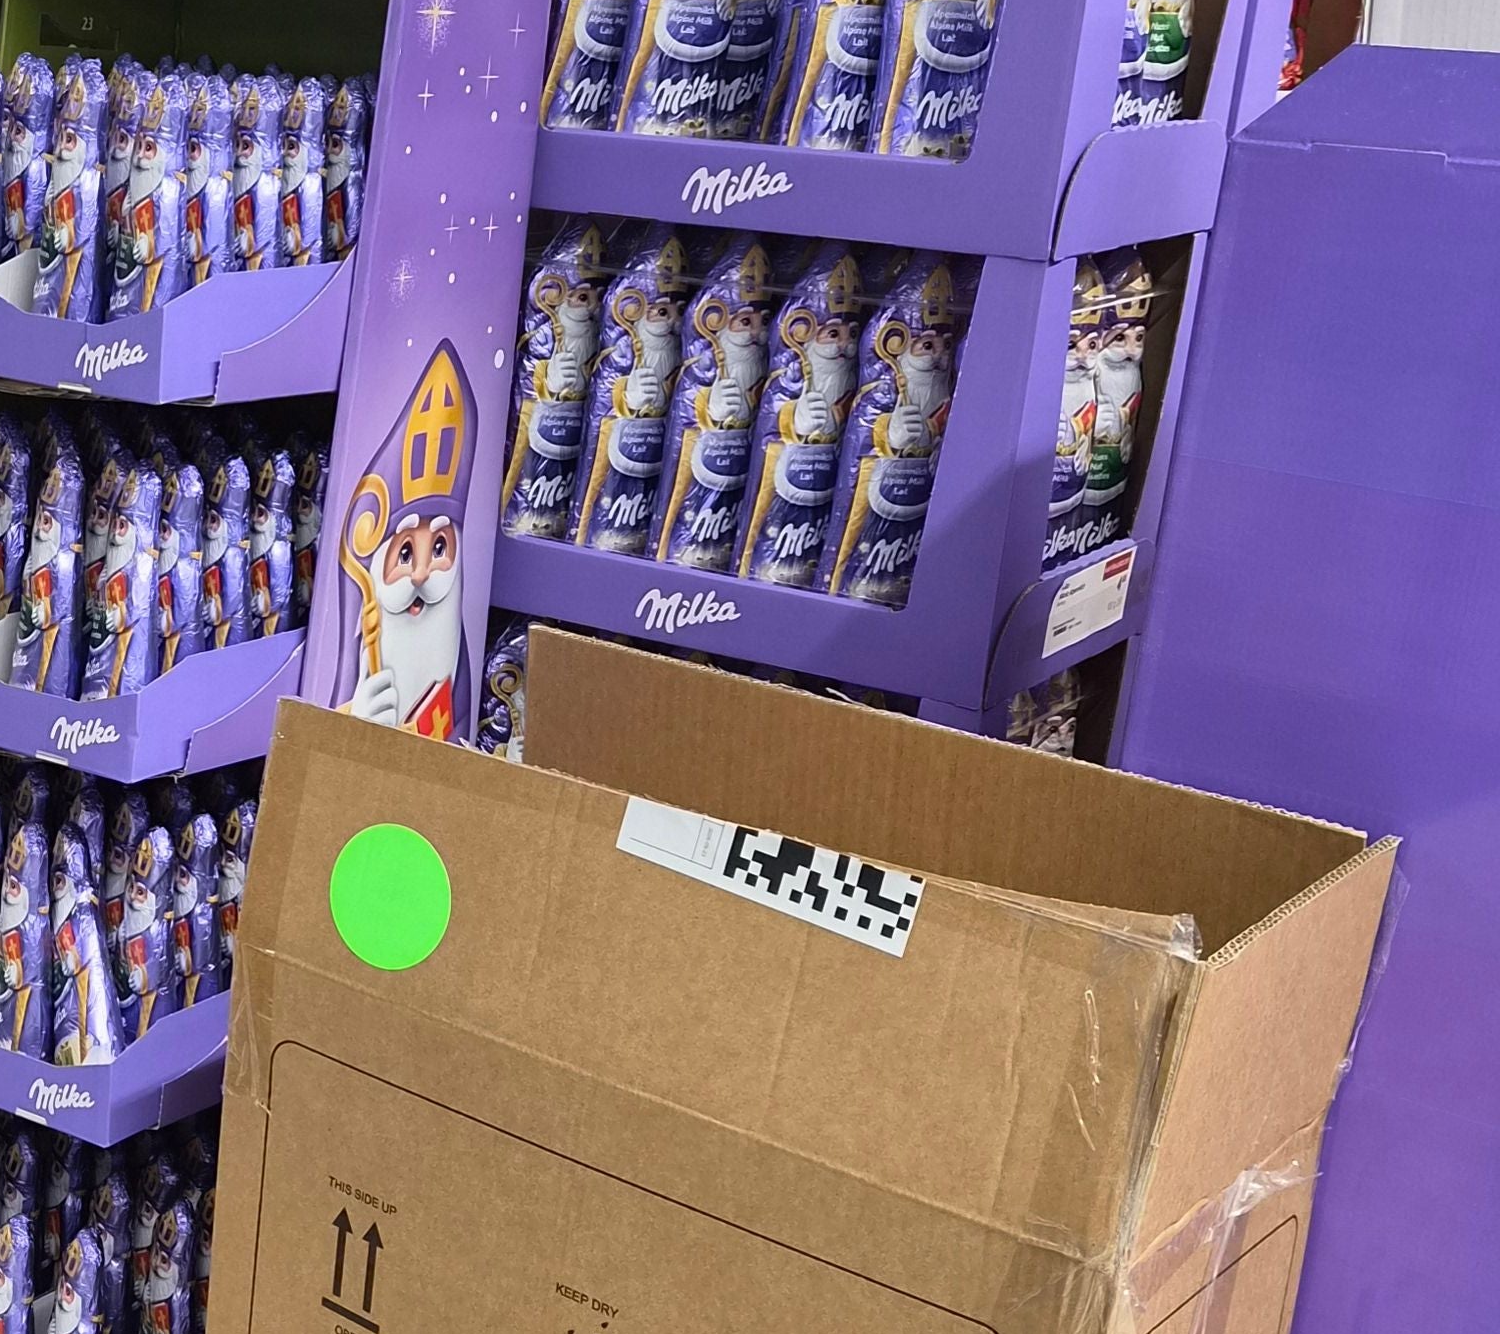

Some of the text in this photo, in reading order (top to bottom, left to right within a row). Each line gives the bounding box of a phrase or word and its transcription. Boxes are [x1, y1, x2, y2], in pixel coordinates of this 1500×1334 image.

[651, 73, 717, 115] Milka
[717, 72, 764, 111] Milk
[681, 161, 793, 215] Milka
[76, 338, 148, 380] Milka
[527, 471, 576, 508] Mil
[866, 529, 922, 574] Milk
[635, 589, 741, 633] Milka
[50, 716, 120, 754] Milka
[29, 1078, 95, 1114] Milka
[328, 1175, 397, 1216] THIS SIDE UP
[556, 1282, 619, 1319] KEEP DRY
